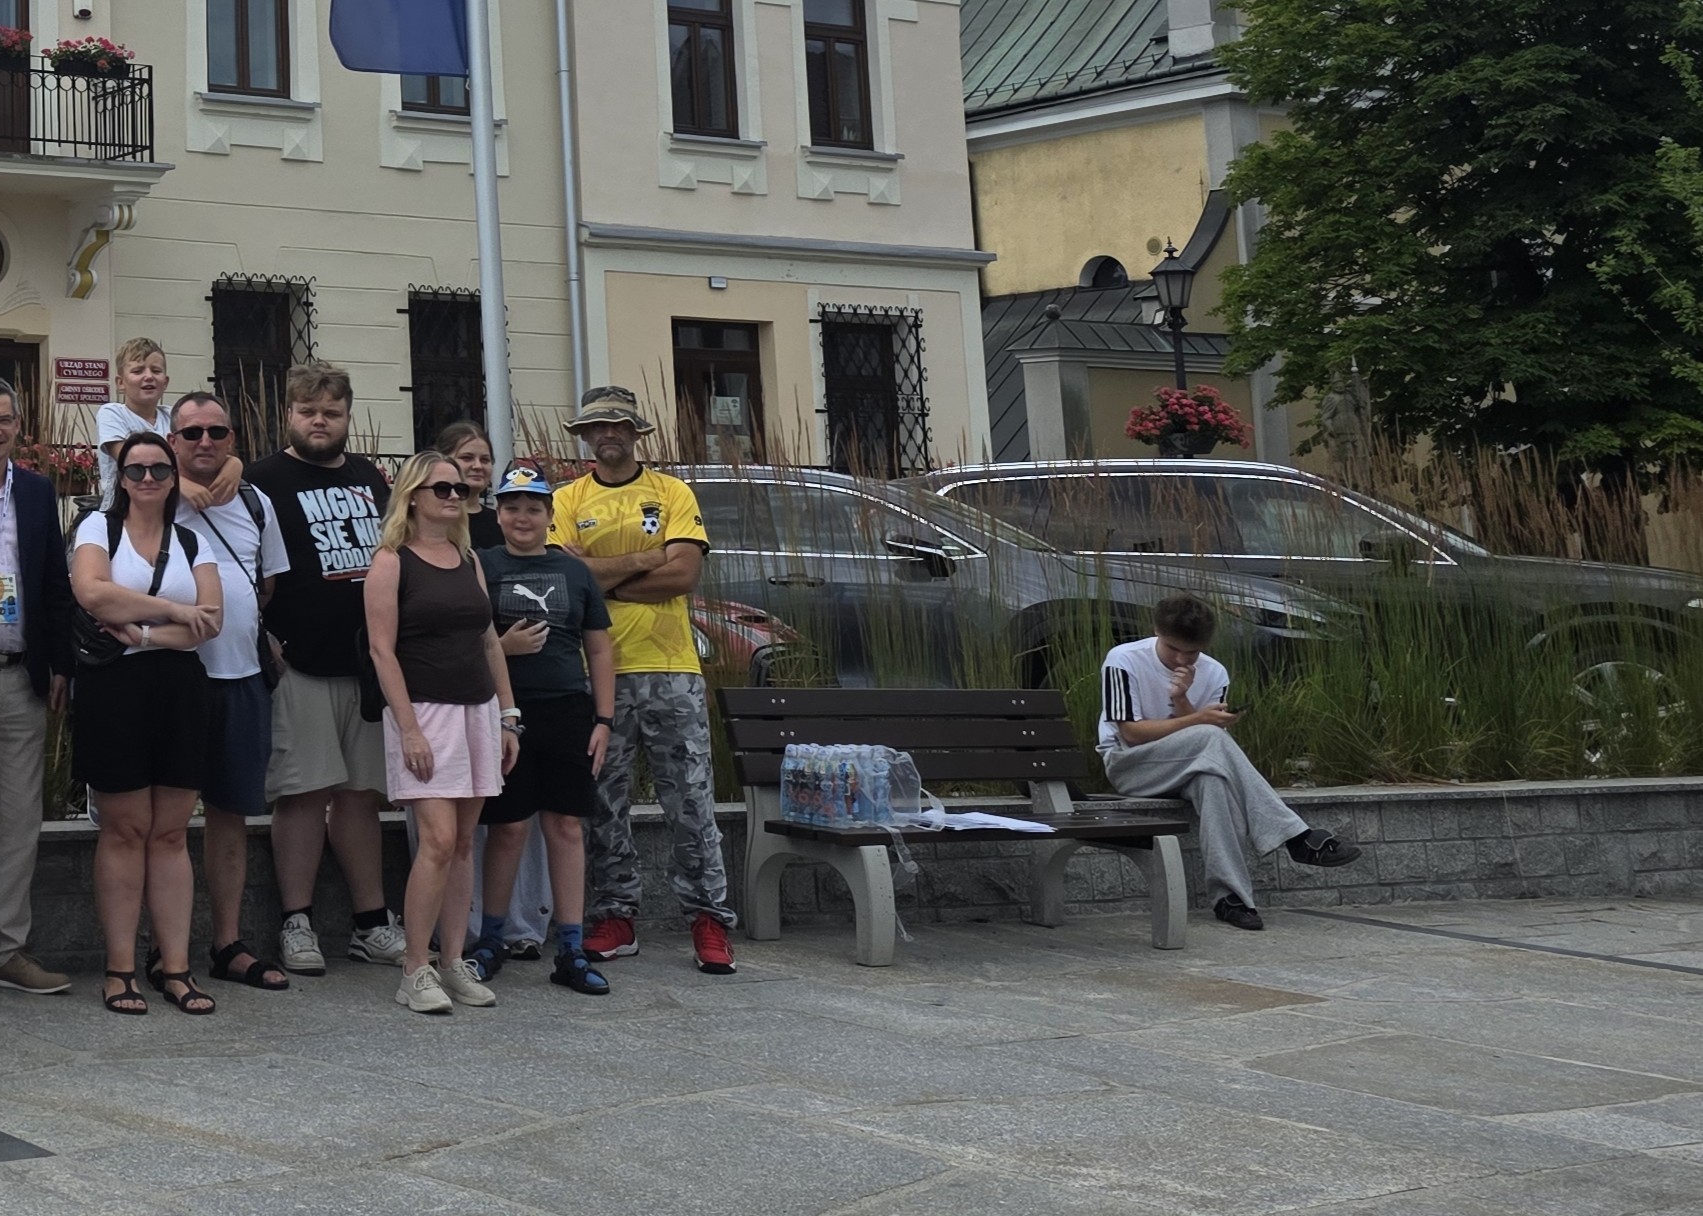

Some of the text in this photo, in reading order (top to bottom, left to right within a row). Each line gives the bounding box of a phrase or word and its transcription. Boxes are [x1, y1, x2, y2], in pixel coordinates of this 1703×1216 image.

[59, 361, 83, 369] URZĄD
[63, 369, 103, 377] CYWILNEGO
[297, 486, 379, 523] NIGDY
[318, 546, 374, 571] PODDA
